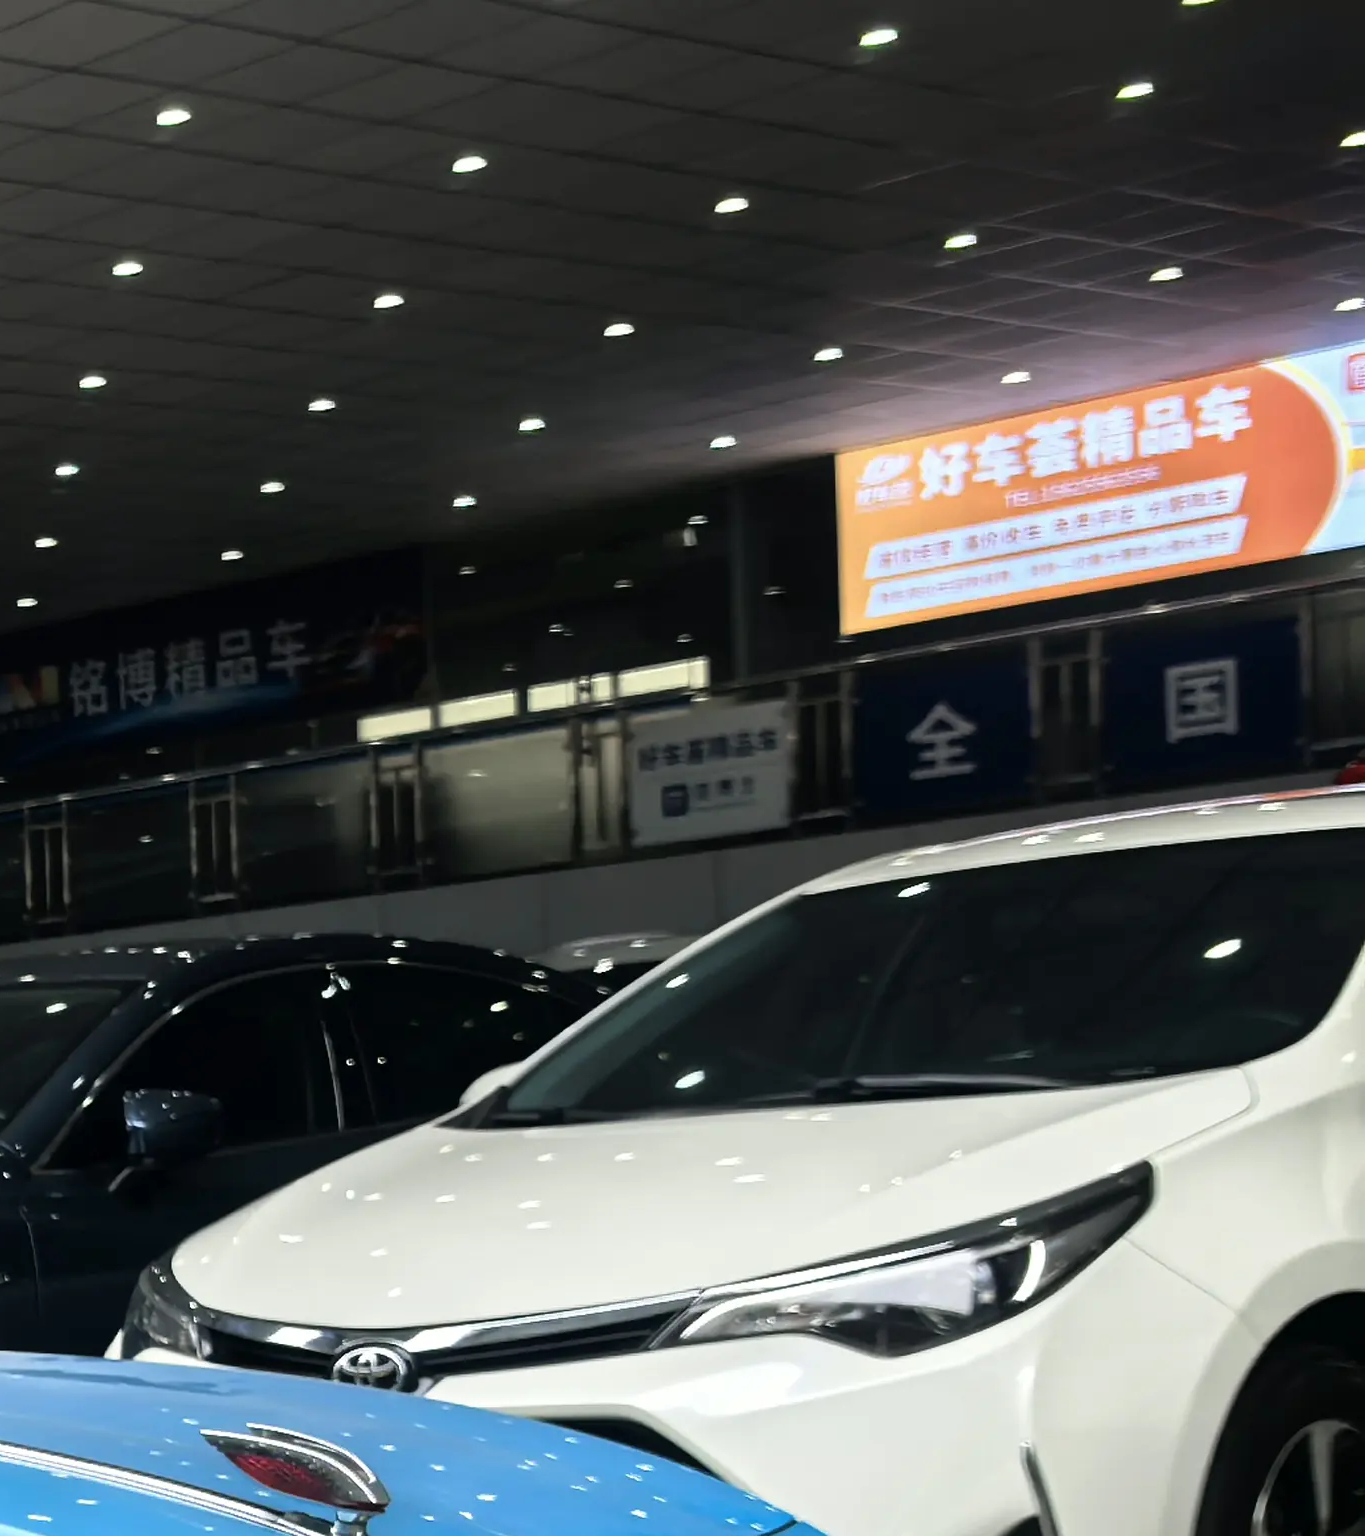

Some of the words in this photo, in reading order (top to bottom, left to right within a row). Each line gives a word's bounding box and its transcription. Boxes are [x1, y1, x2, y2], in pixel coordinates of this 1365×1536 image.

[917, 384, 1254, 502] 好车荟精品车
[68, 617, 314, 718] 铭博精品车
[907, 701, 977, 781] 全
[1166, 658, 1239, 744] 国
